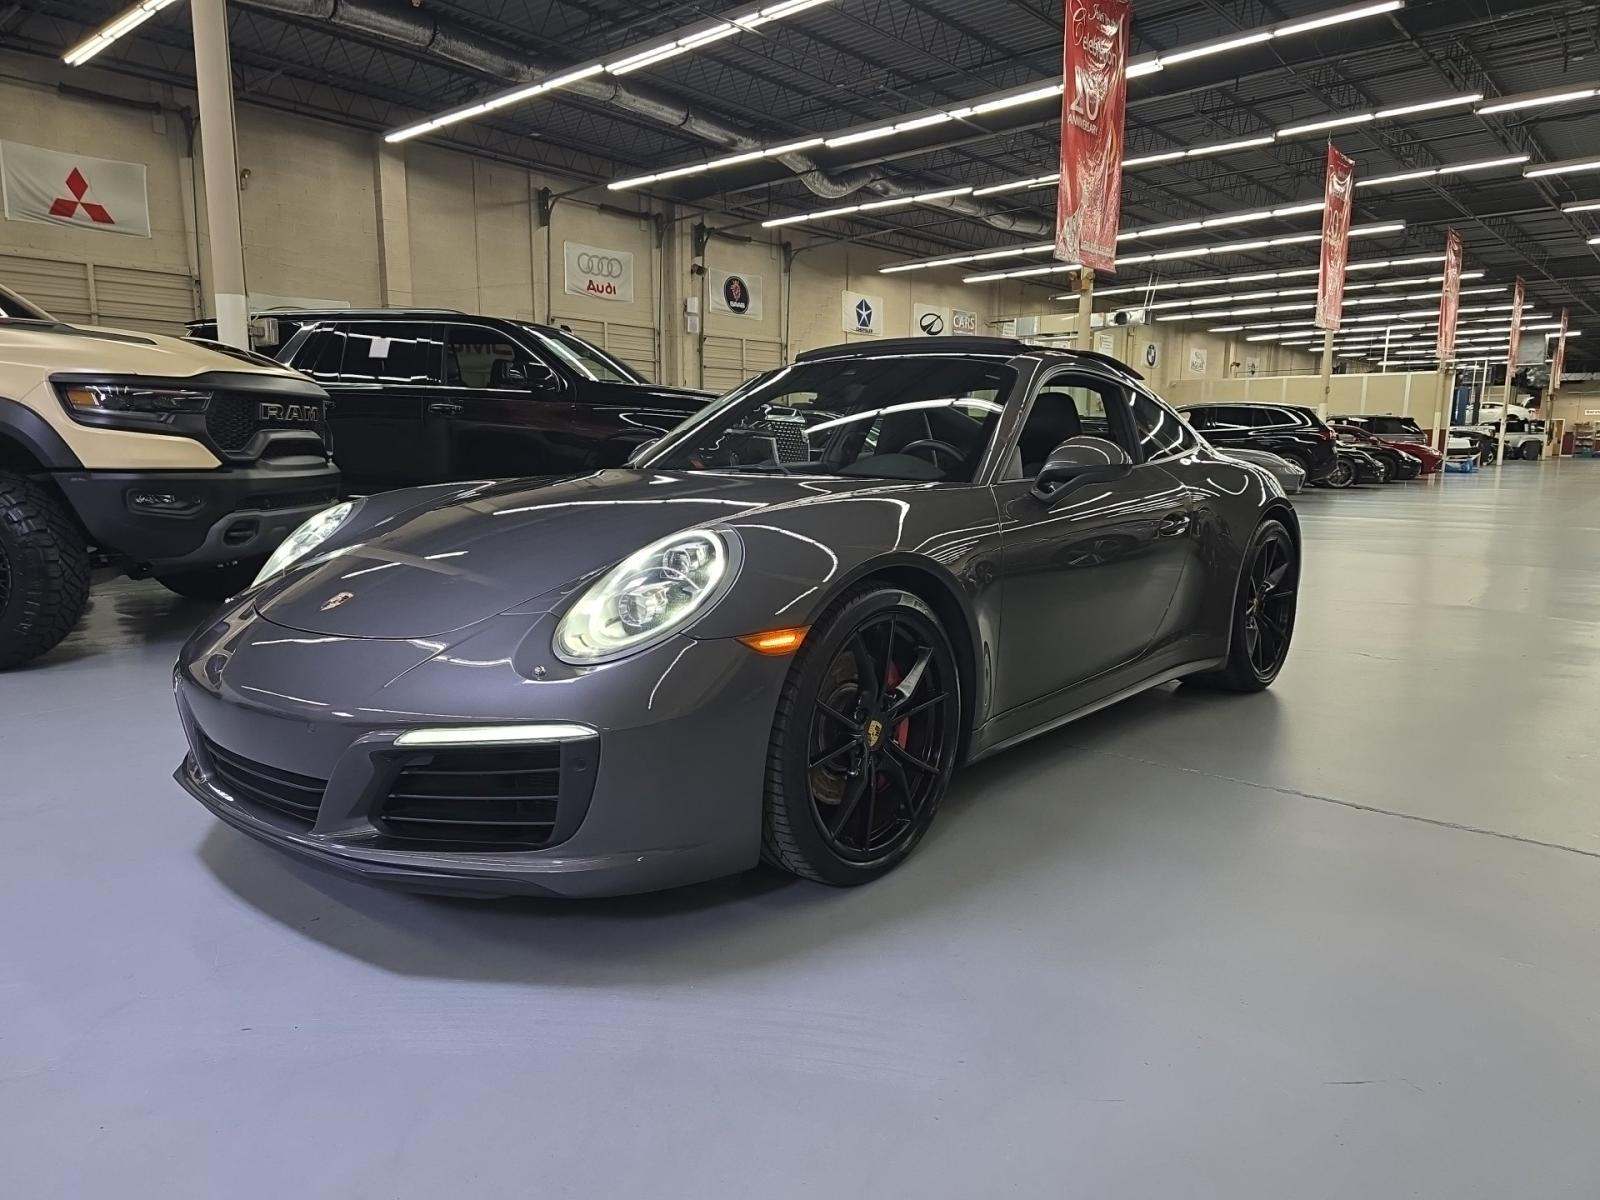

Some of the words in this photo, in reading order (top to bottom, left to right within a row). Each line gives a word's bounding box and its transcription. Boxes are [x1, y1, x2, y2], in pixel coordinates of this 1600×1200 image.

[586, 279, 617, 295] Audi
[953, 315, 975, 330] CARS
[260, 402, 319, 421] RAM
